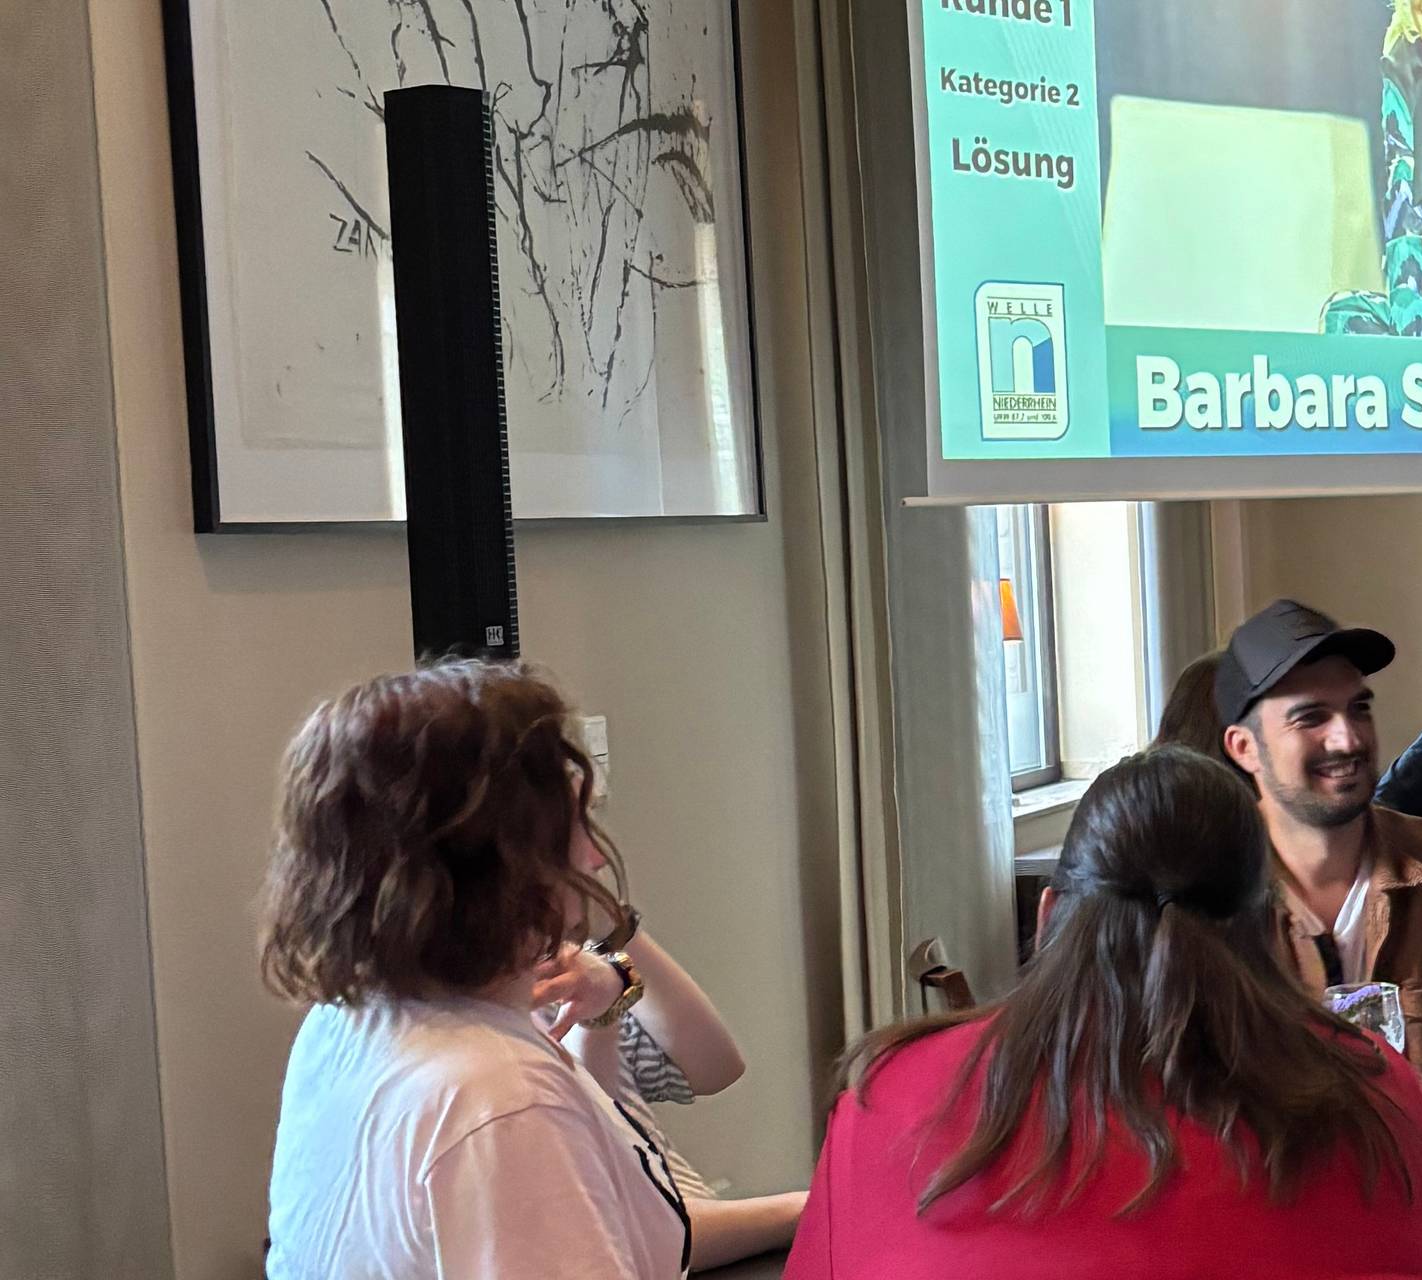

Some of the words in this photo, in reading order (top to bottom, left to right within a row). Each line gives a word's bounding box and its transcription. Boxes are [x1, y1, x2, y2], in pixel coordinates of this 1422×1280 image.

[1060, 0, 1072, 27] 1
[940, 66, 1061, 105] Kategorie
[1066, 83, 1080, 106] 2
[952, 136, 1075, 189] Lösung
[987, 301, 1053, 315] WELLE
[993, 396, 1057, 410] NIEDERRHEIN
[1136, 354, 1390, 431] Barbara
